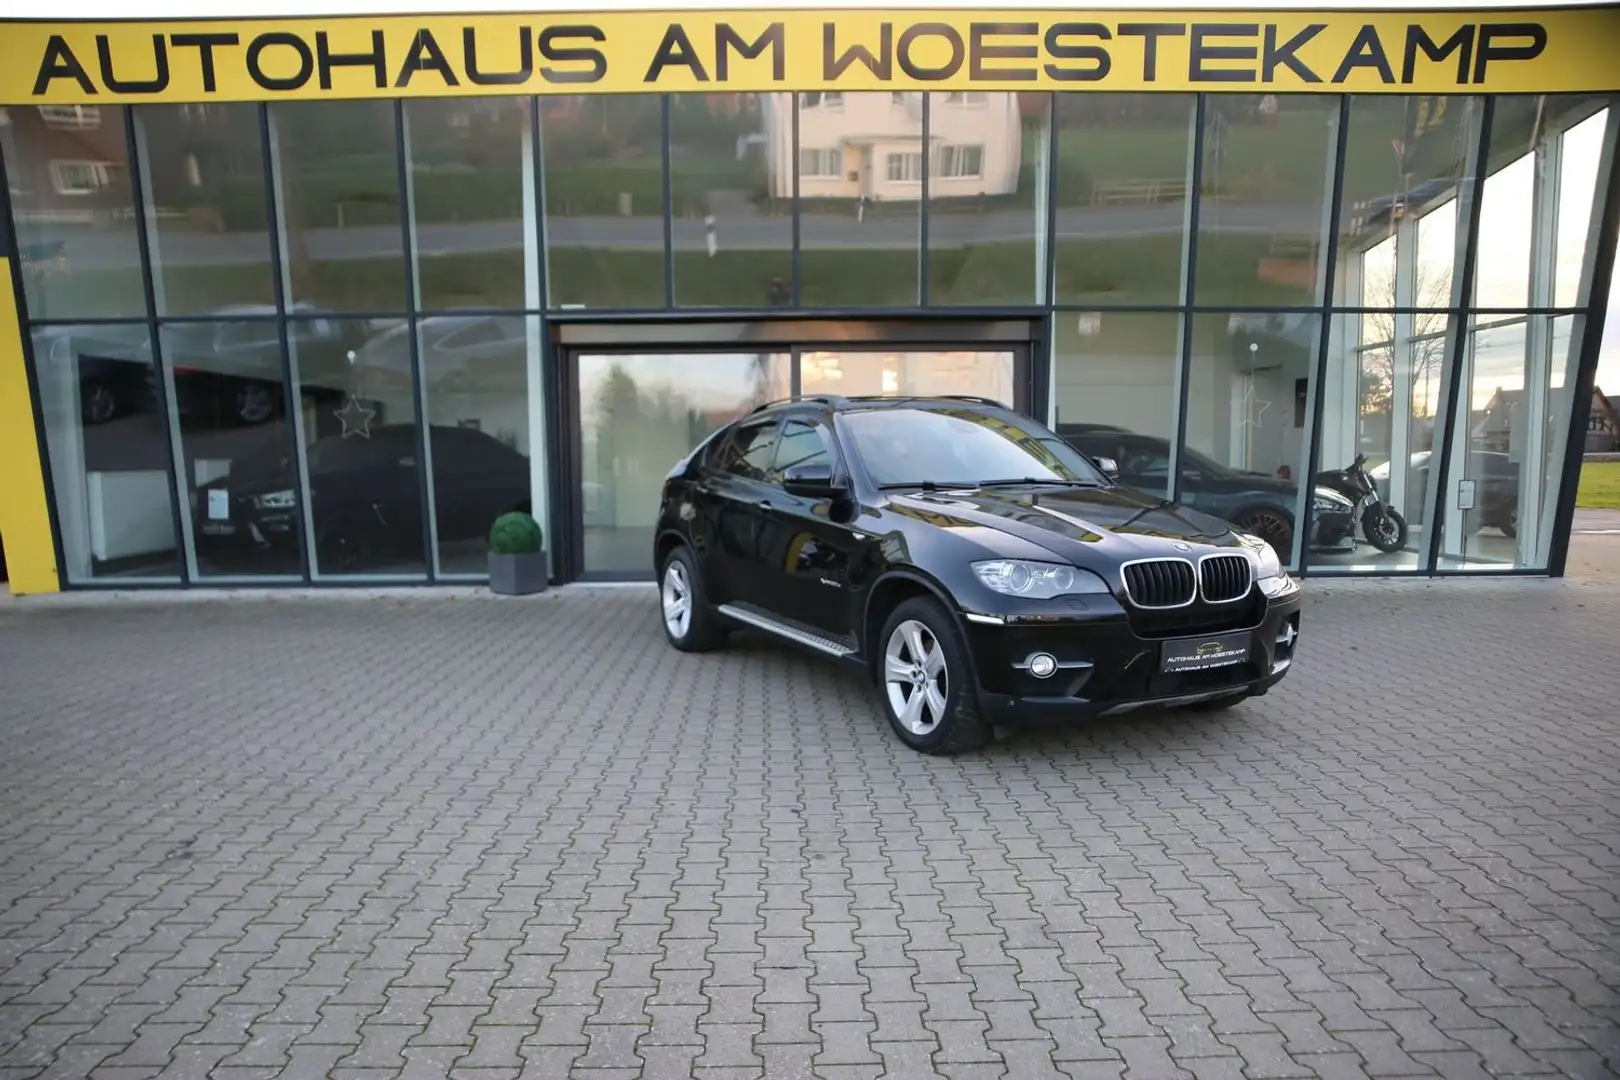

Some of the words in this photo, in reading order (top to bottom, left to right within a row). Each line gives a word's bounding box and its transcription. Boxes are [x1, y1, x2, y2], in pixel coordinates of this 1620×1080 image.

[33, 25, 608, 97] AUTOHAUS
[645, 23, 785, 83] AM
[823, 20, 1550, 85] WOESTEKAMP
[1167, 655, 1201, 663] AUTOHAUS
